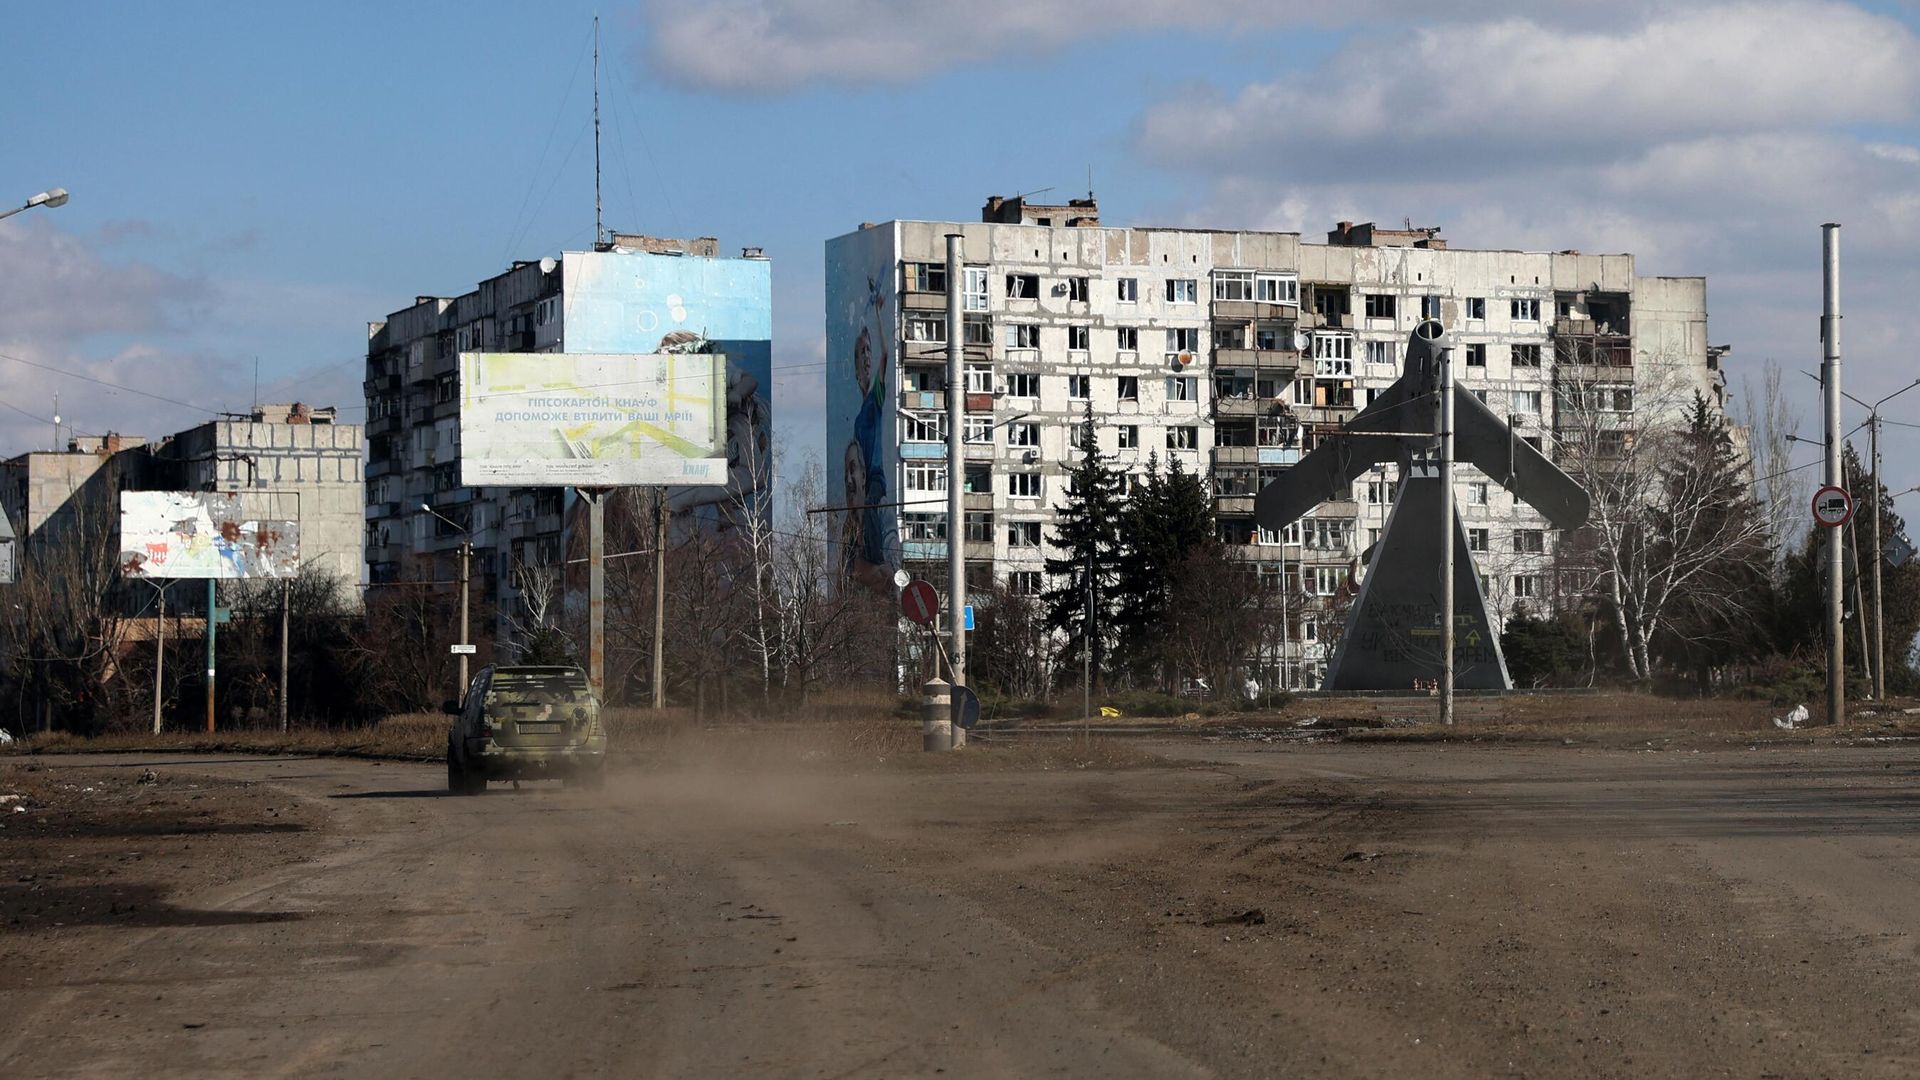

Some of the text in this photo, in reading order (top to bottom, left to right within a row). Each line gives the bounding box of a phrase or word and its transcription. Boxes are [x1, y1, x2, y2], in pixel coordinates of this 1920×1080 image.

[528, 398, 657, 407] ГІПСОКАРТОН КНАУФ
[495, 412, 568, 422] ДОПОМОЖЕ
[574, 412, 622, 421] ВТІЛИТИ
[628, 412, 659, 421] ВАШІ
